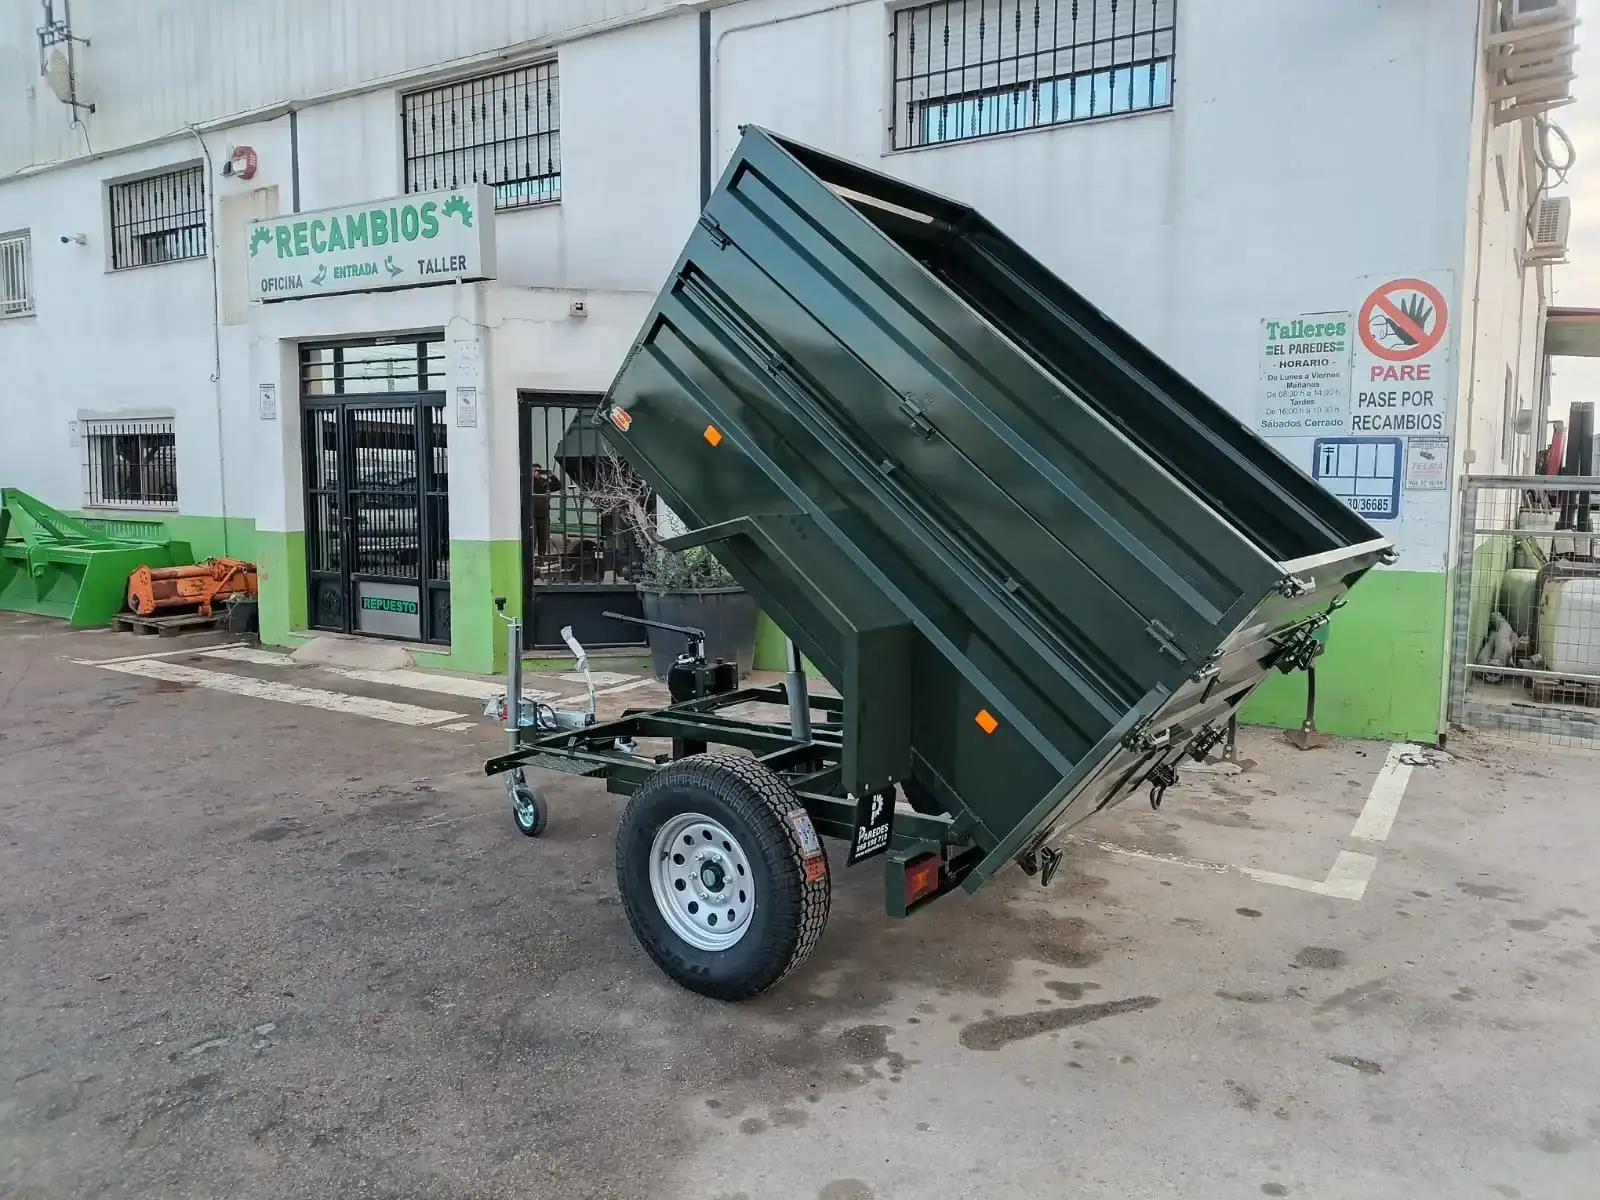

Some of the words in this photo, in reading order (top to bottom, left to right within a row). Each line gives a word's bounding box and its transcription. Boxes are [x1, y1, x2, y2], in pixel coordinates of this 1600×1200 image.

[275, 201, 439, 259] RECAMBIOS
[261, 275, 303, 292] OFICINA
[333, 262, 379, 279] ENTRADA
[418, 255, 467, 275] TALLER
[1266, 320, 1346, 340] Talleres
[1274, 345, 1285, 355] EL
[1289, 342, 1336, 354] PAREDES
[1279, 359, 1329, 368] HORARIO
[1370, 364, 1431, 382] PARE
[1358, 391, 1397, 408] PASE
[1402, 390, 1434, 407] POR
[1261, 419, 1302, 428] Sábados
[1304, 418, 1343, 427] Cerrado
[1352, 413, 1442, 431] RECAMBIOS
[363, 598, 417, 613] REPUESTO
